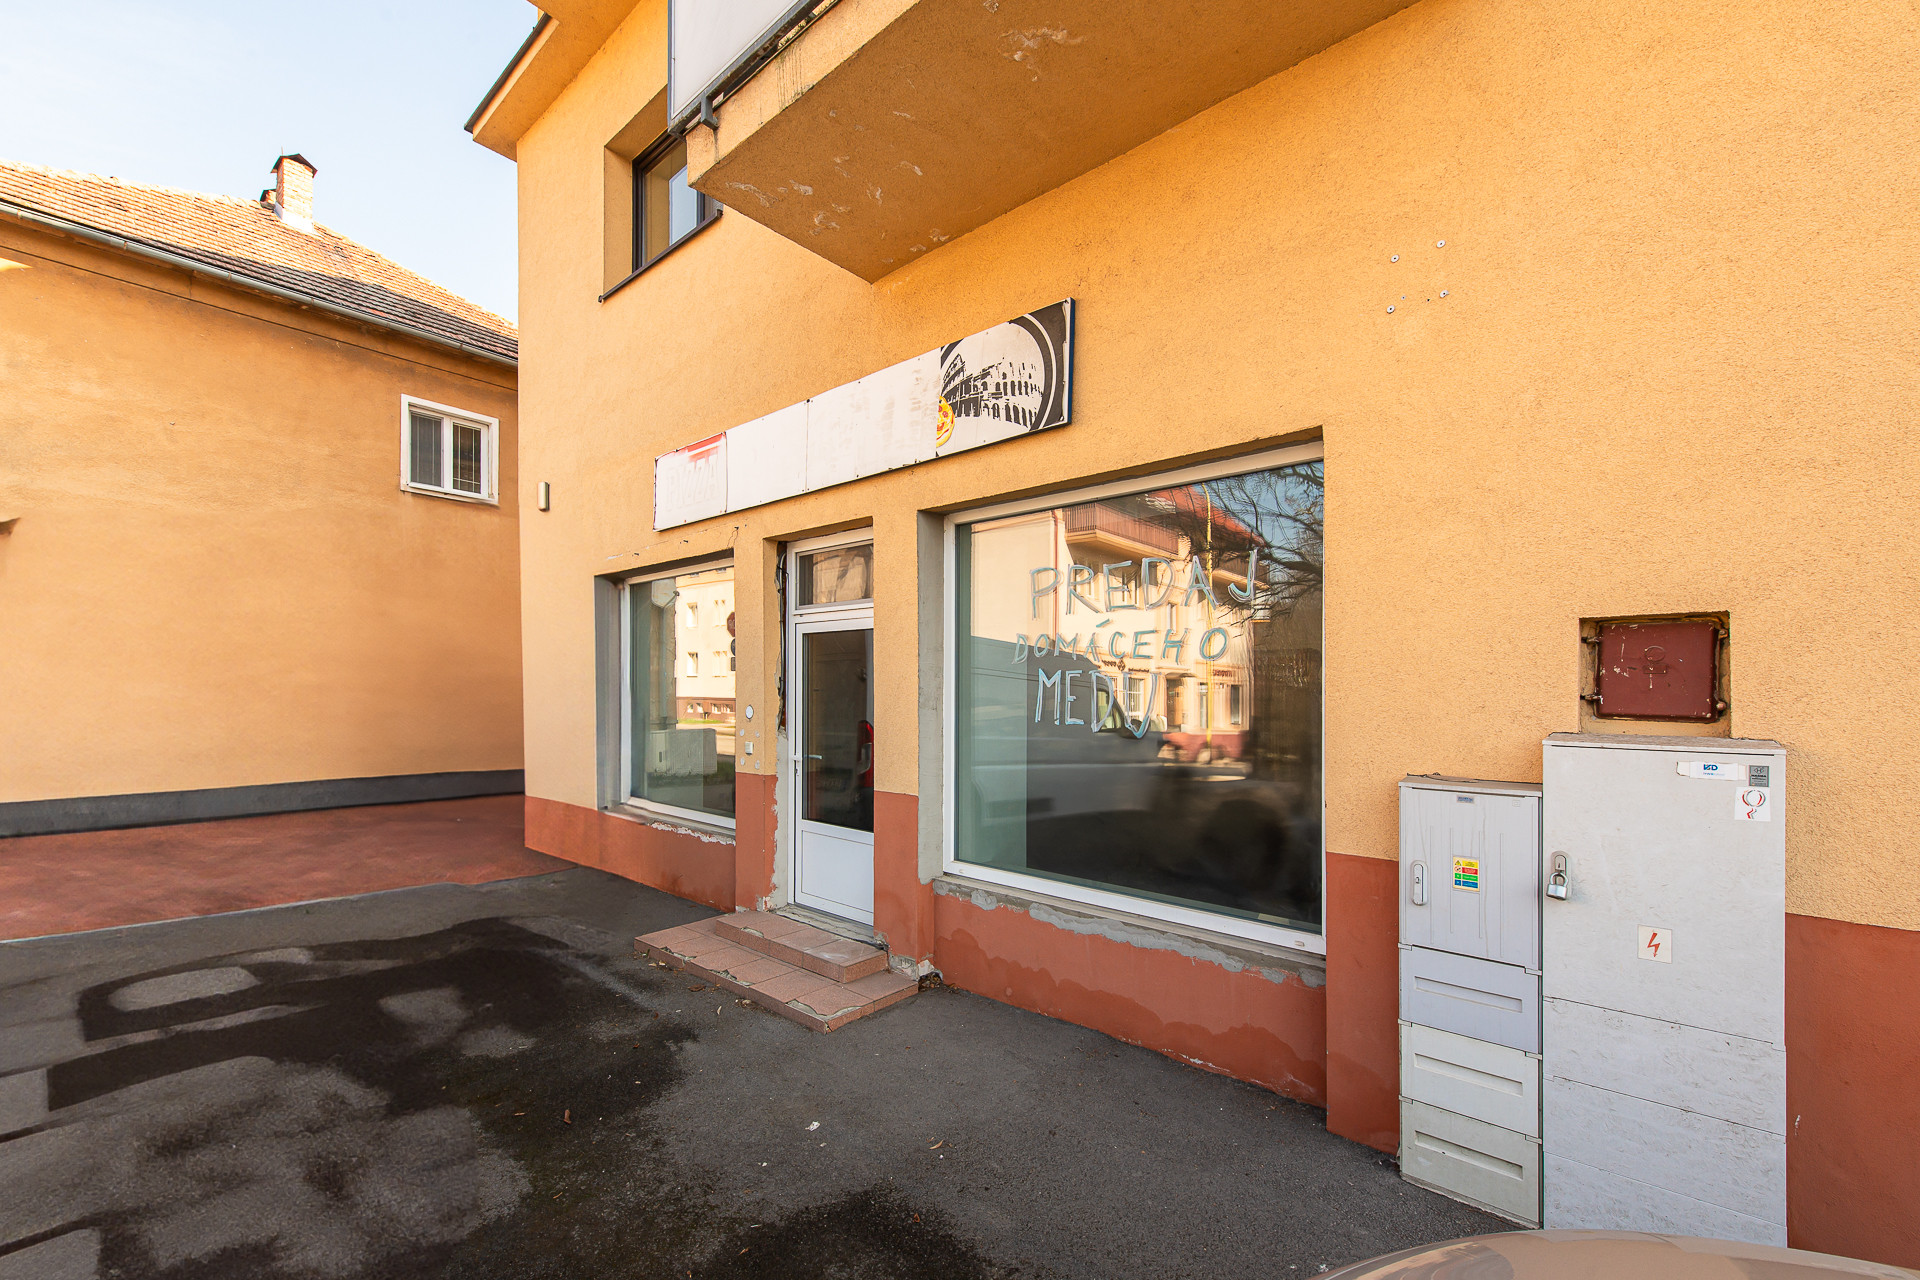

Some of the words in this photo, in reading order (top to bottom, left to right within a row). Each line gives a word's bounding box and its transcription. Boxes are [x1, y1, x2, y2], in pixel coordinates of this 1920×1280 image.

[1030, 548, 1258, 620] PREDAJ
[1011, 618, 1230, 665] DOMÁCEHO
[1035, 668, 1161, 739] MEDU
